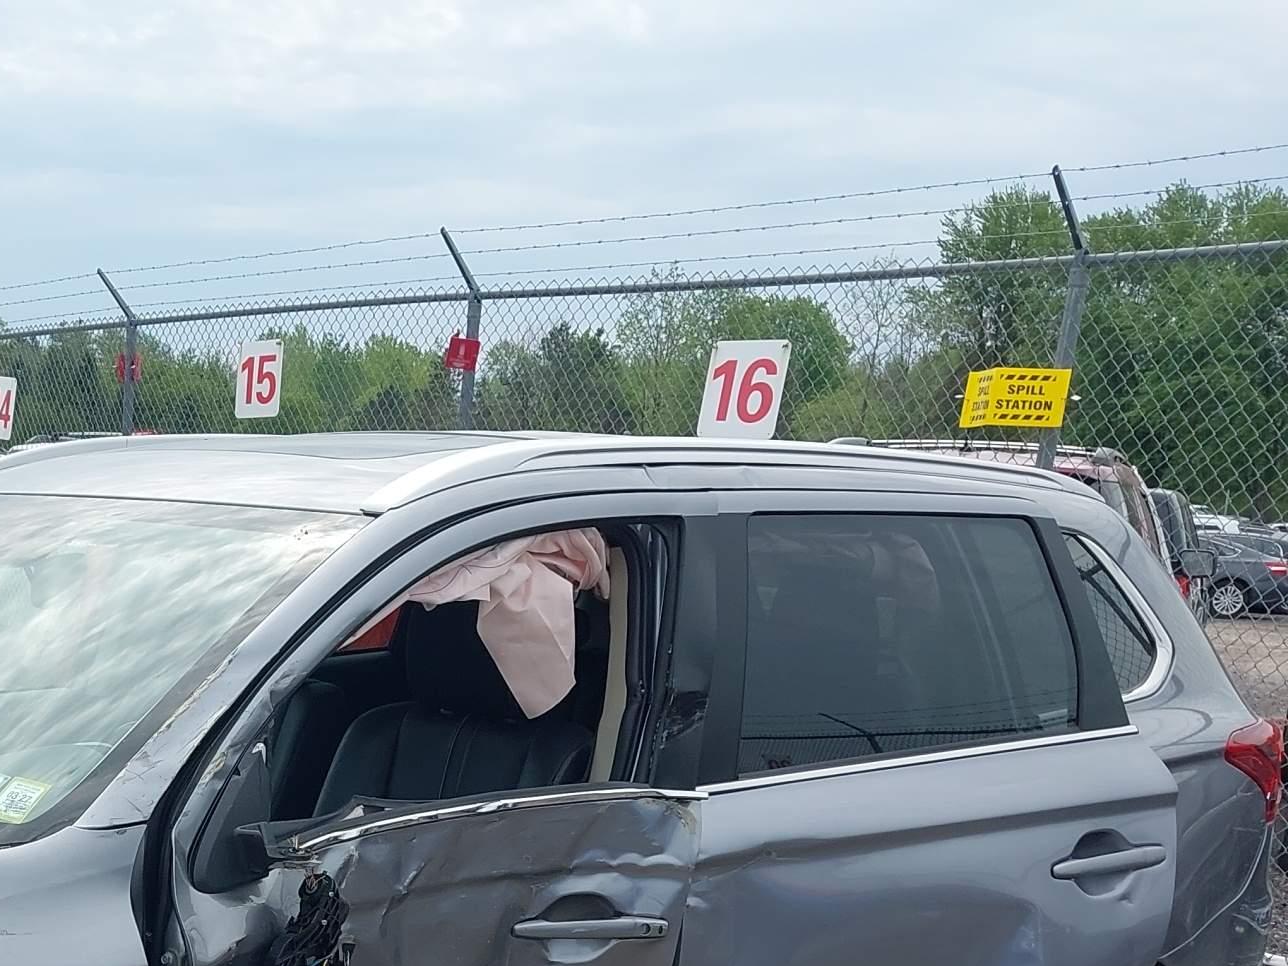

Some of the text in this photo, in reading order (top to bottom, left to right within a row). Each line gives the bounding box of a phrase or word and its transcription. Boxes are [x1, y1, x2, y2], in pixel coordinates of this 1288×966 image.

[241, 355, 277, 405] 15
[712, 358, 778, 424] 16
[1007, 384, 1046, 396] SPILL
[995, 399, 1053, 411] STATION
